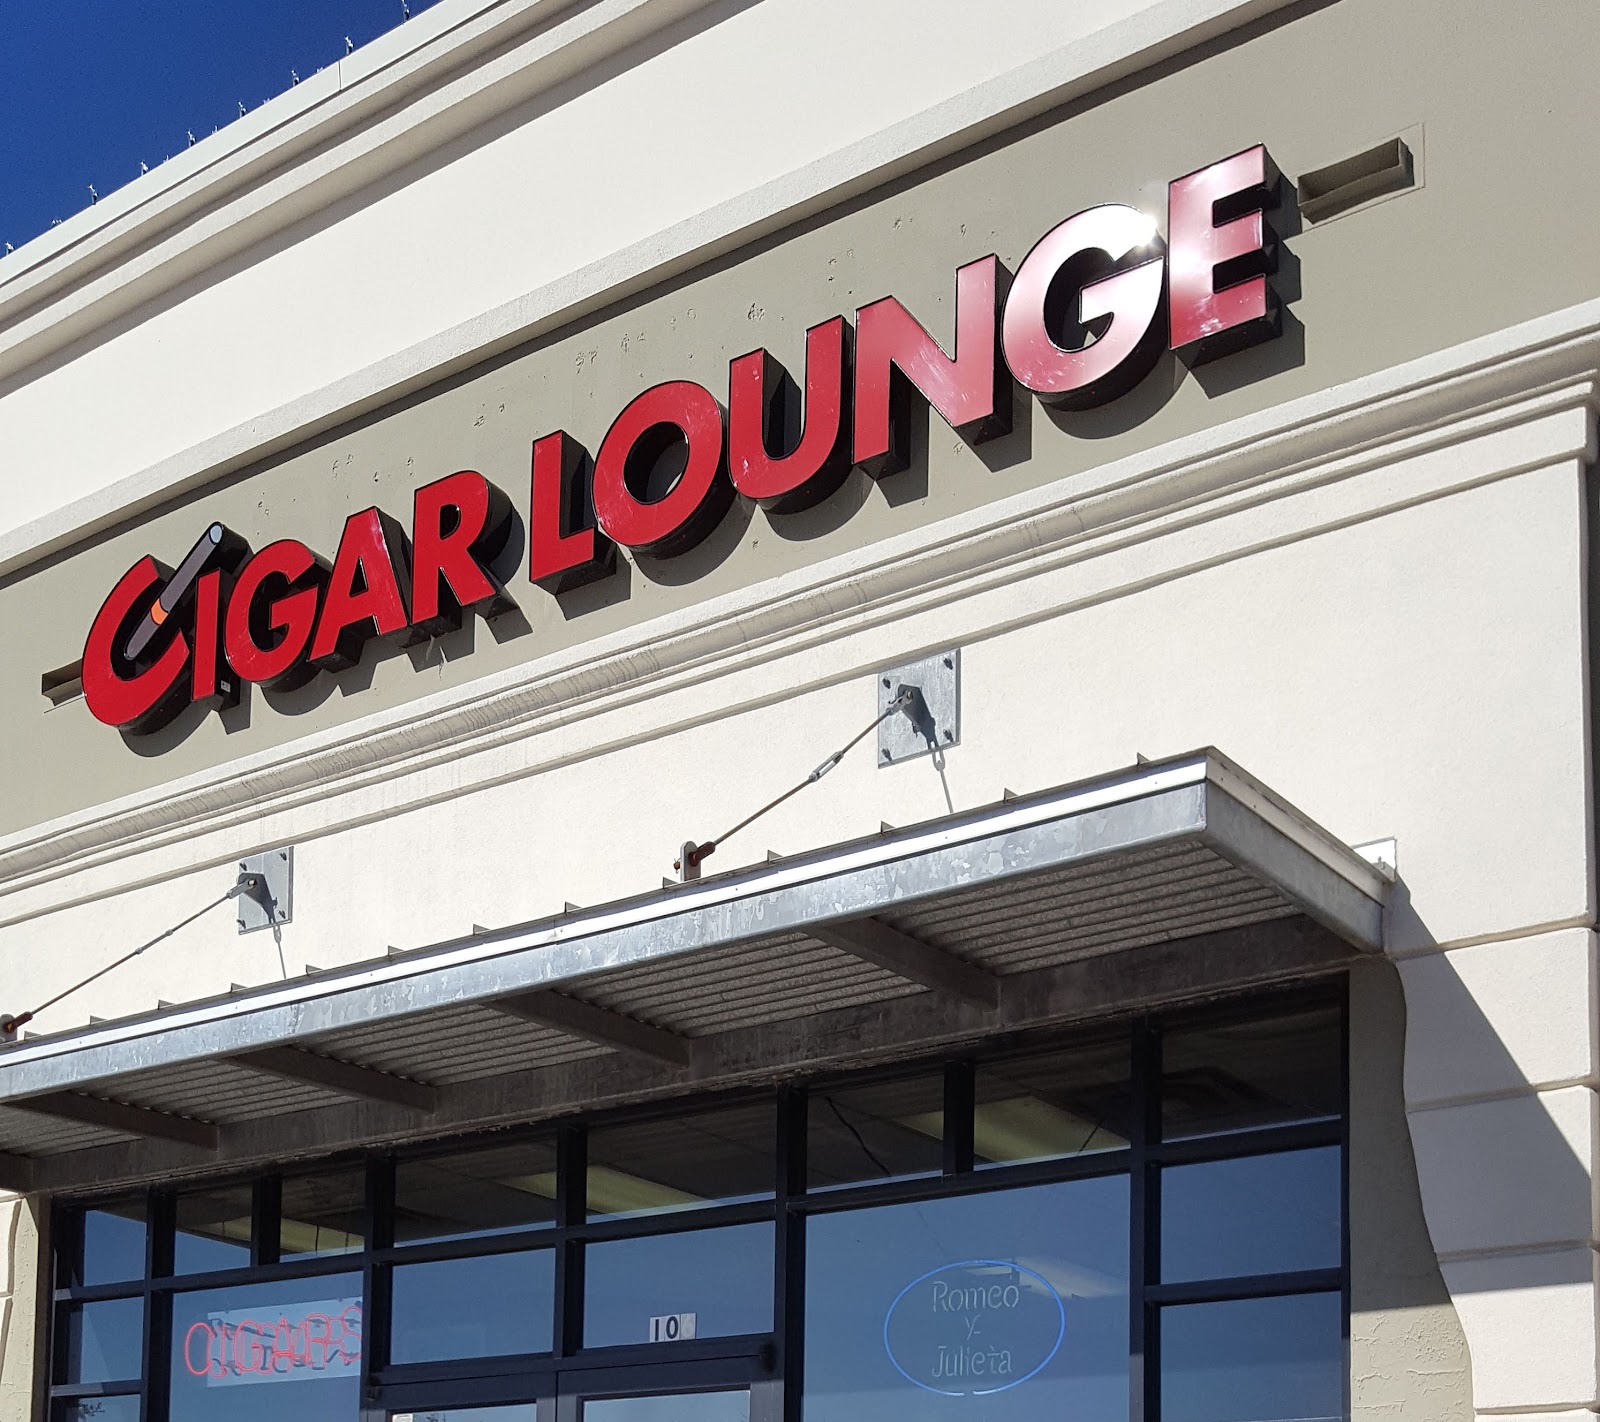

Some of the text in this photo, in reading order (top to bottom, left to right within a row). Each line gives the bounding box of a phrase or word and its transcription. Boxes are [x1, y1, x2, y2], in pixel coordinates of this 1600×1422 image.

[82, 143, 1272, 728] CIGAR LOUNGE
[931, 1280, 1020, 1312] Romeo
[184, 1305, 362, 1378] CIGARS
[931, 1345, 1012, 1378] Julieta
